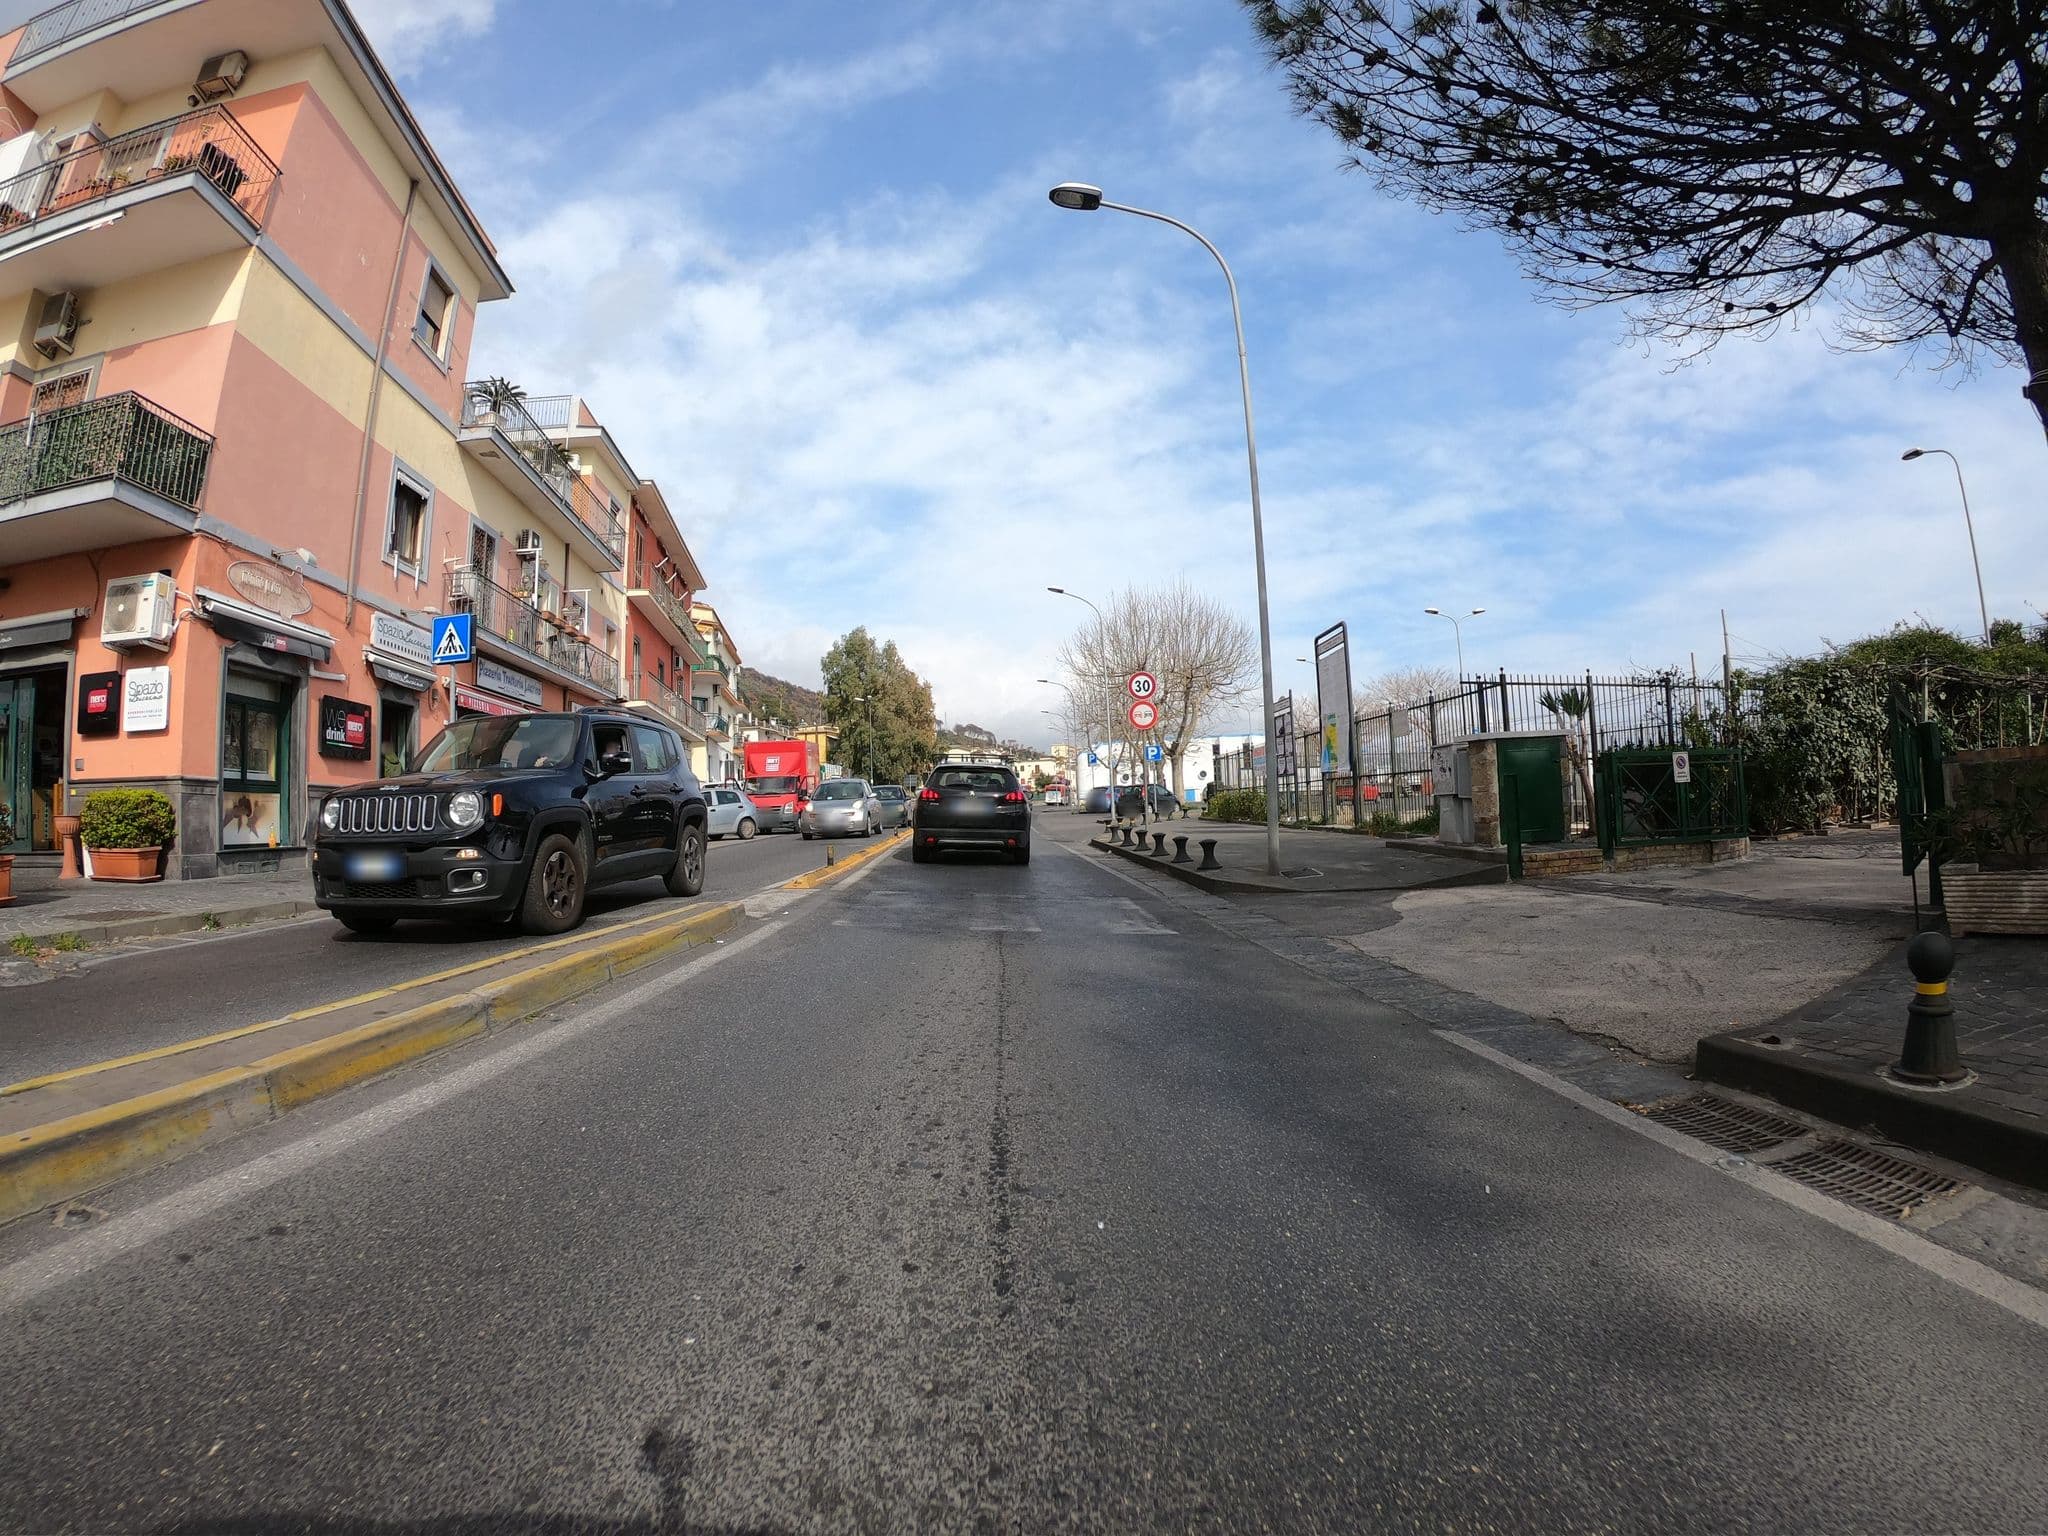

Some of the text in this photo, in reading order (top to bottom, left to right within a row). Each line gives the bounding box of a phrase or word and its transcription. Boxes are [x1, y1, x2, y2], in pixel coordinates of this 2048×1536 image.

[128, 680, 163, 697] Spazio
[1135, 680, 1150, 692] 30
[325, 707, 346, 728] we
[325, 727, 346, 741] drink
[1089, 755, 1095, 763] P
[1147, 747, 1158, 759] P
